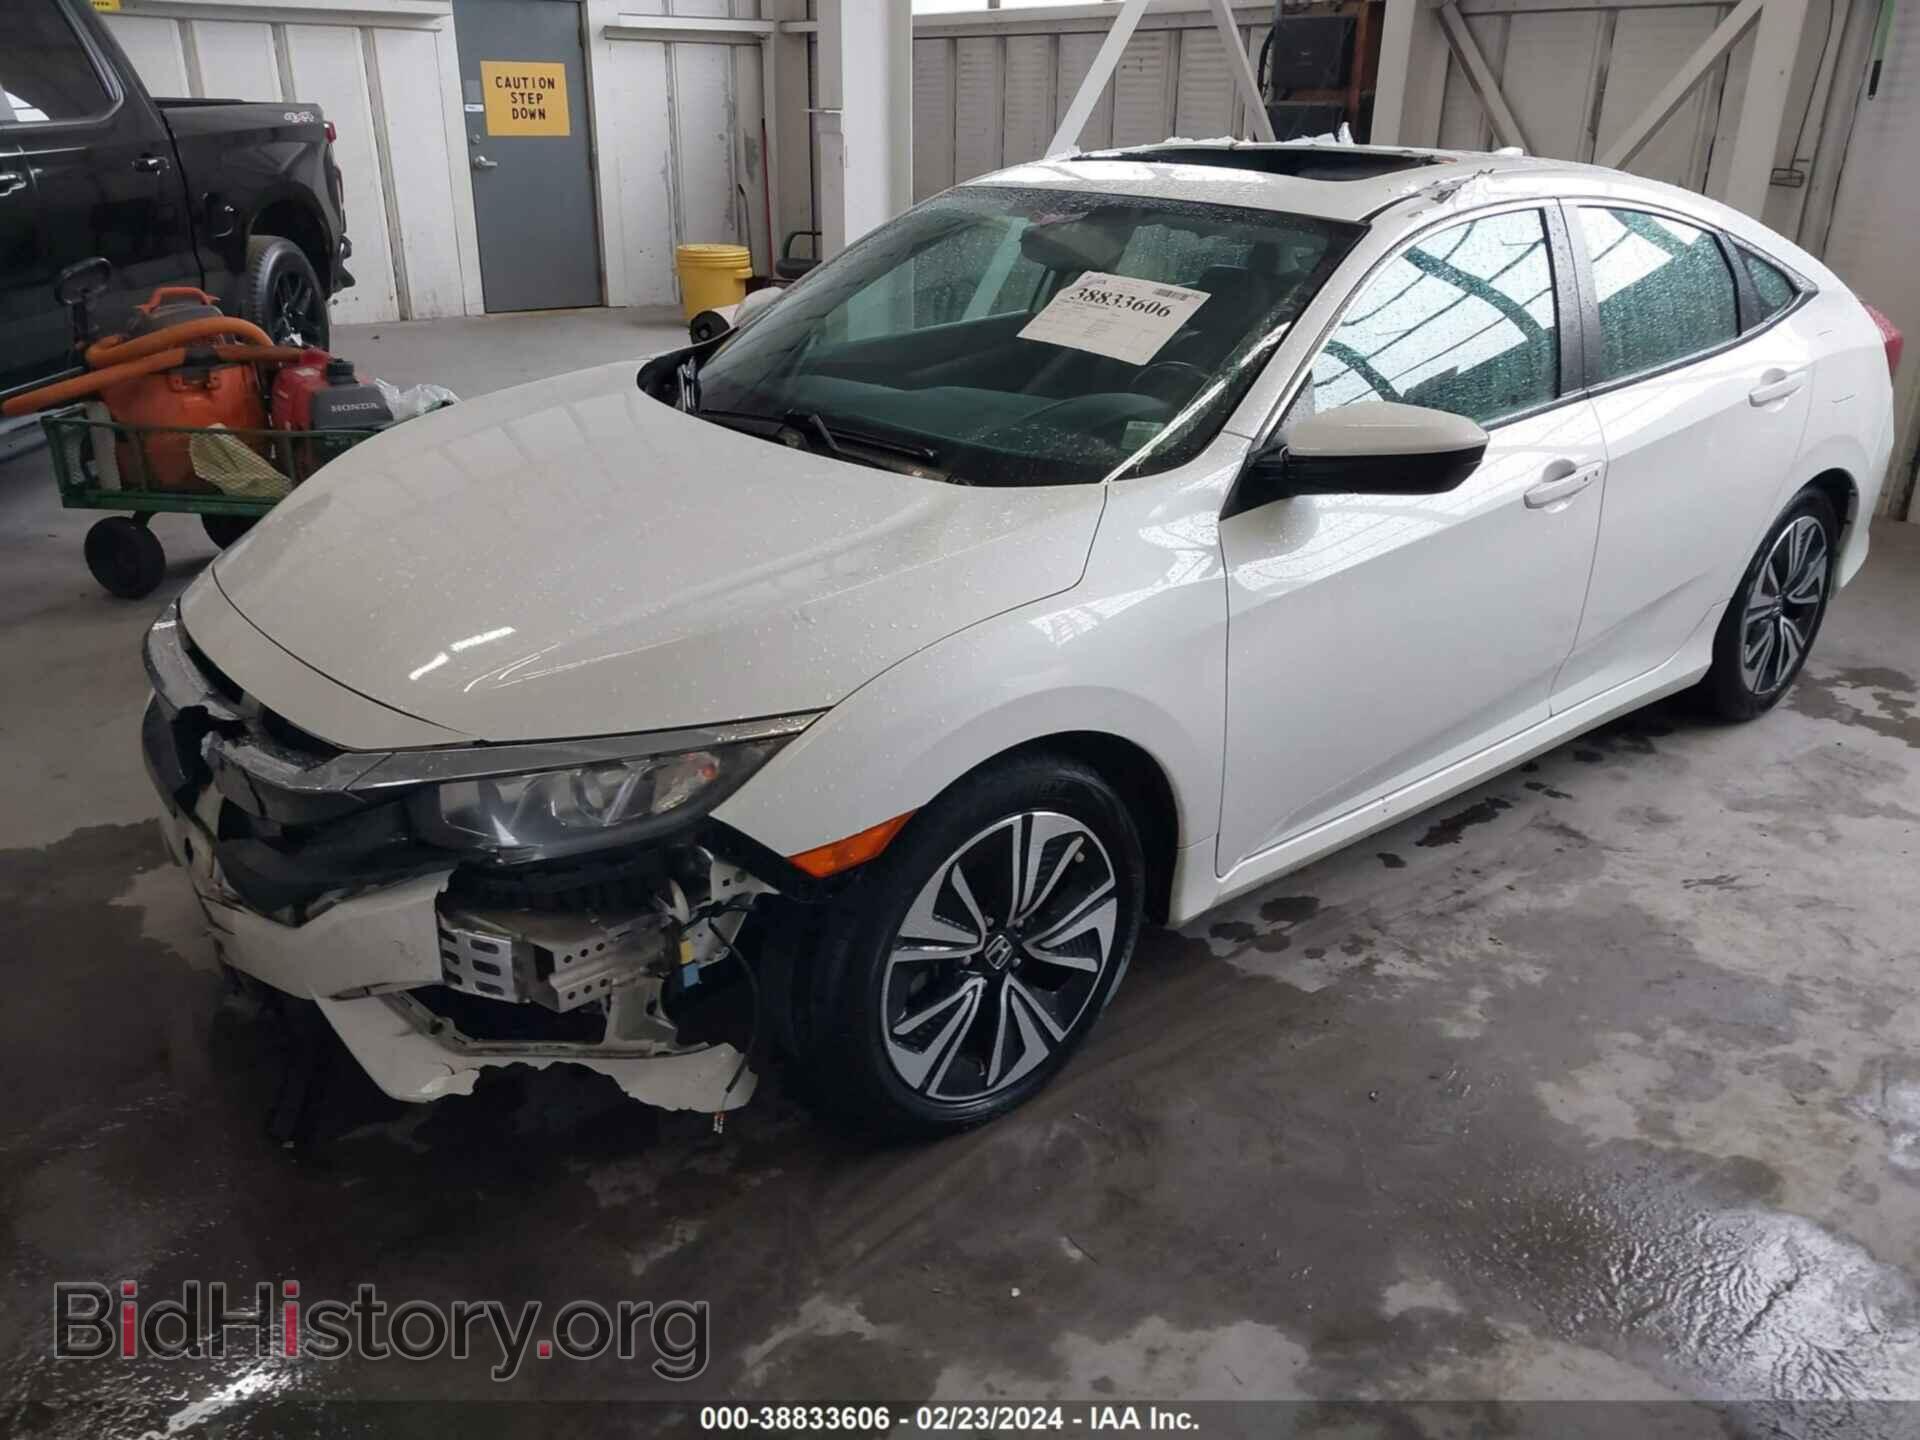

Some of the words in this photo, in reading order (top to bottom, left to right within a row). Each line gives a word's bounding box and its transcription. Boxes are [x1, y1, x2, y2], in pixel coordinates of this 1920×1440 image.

[495, 76, 555, 89] CAUTION
[510, 92, 543, 104] STEP
[512, 107, 546, 120] DOWN
[1069, 287, 1171, 319] 38833606
[330, 402, 379, 412] HONDA
